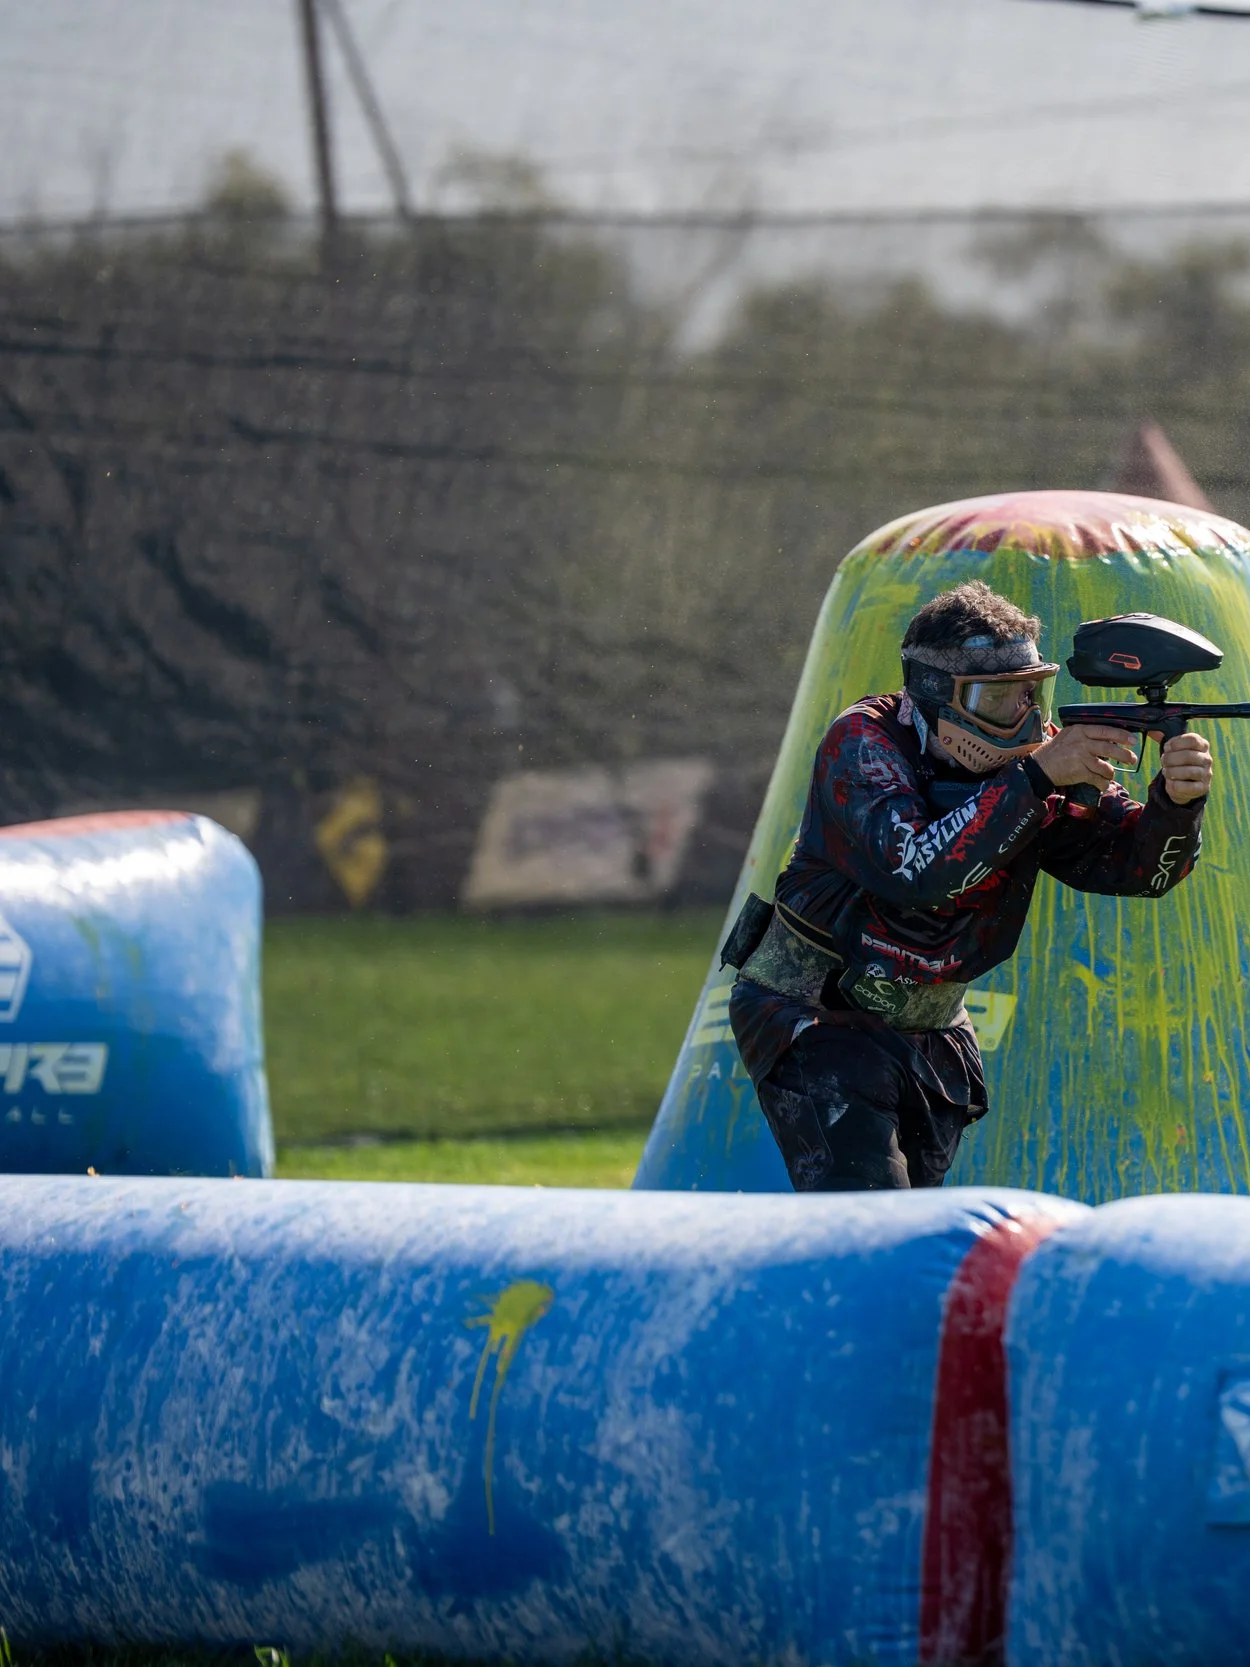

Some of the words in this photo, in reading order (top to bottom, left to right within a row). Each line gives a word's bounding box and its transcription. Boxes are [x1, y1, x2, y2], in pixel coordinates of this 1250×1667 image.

[913, 802, 980, 874] ASYLUM
[1007, 808, 1036, 843] CRBN
[853, 983, 897, 1012] carbon
